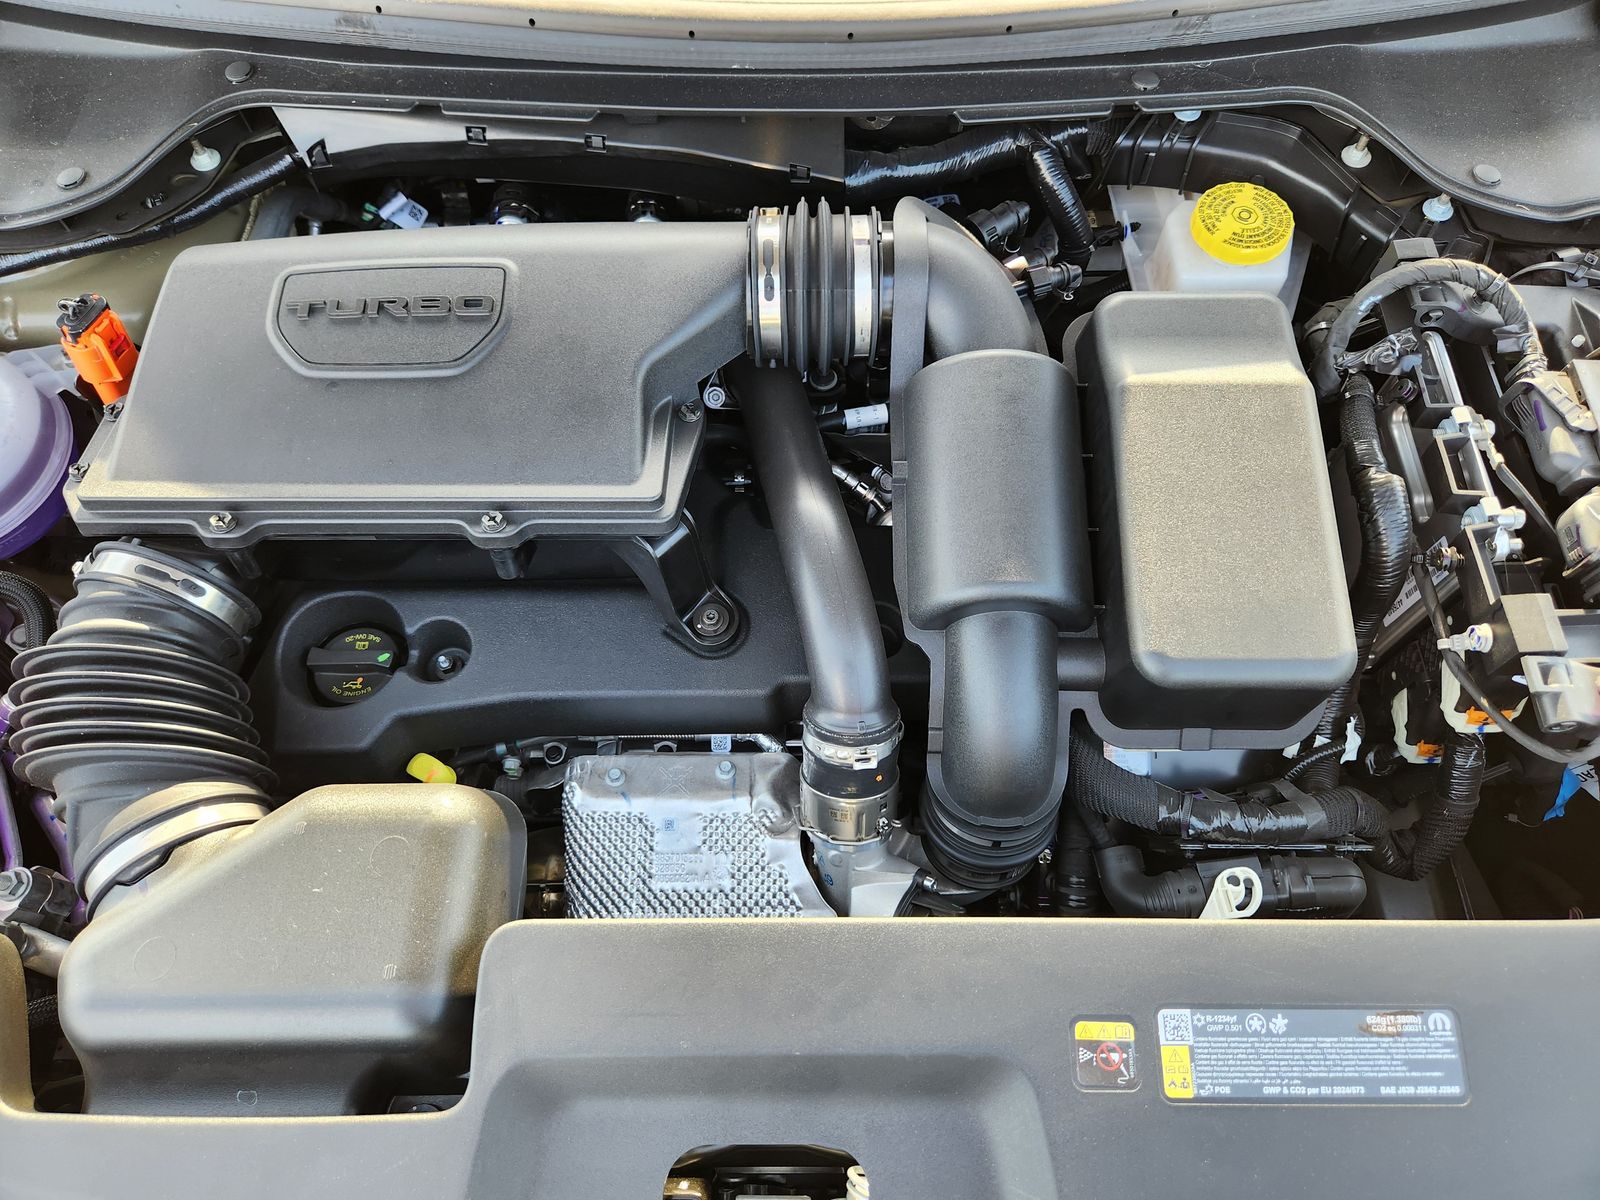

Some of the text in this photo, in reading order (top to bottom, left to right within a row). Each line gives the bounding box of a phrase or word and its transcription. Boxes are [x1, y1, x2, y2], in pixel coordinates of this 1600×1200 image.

[285, 294, 496, 321] TURBO
[345, 633, 382, 643] SAE 0W-20
[329, 685, 372, 697] ENGINE OIL
[1206, 1014, 1237, 1025] R-1234yf
[1206, 1024, 1242, 1032] GWP 0.501
[1371, 1025, 1386, 1033] CO2
[1262, 1086, 1281, 1095] GWP
[1290, 1086, 1306, 1095] CO2
[1307, 1087, 1319, 1096] per
[1320, 1086, 1332, 1095] EU
[1380, 1086, 1397, 1095] SAE
